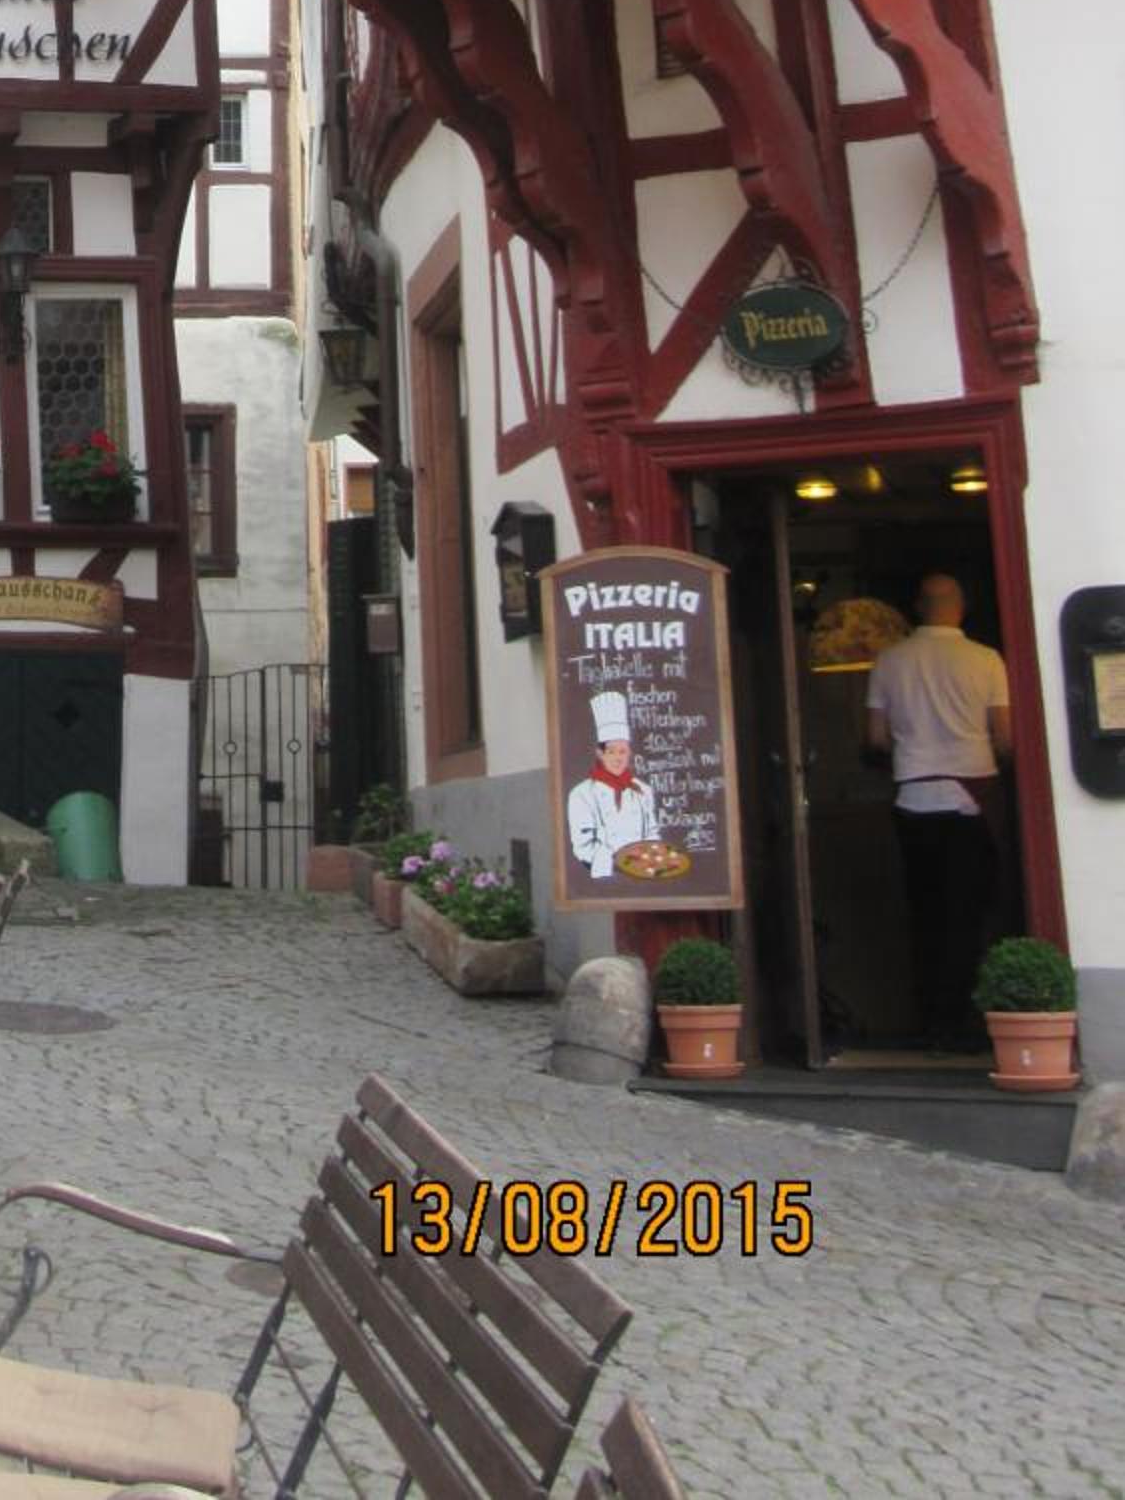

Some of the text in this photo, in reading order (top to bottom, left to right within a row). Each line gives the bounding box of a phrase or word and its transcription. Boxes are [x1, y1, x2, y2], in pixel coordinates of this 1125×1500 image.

[739, 308, 828, 349] Pizzeria
[564, 580, 700, 617] Pizzeria
[585, 621, 684, 650] ITALIA
